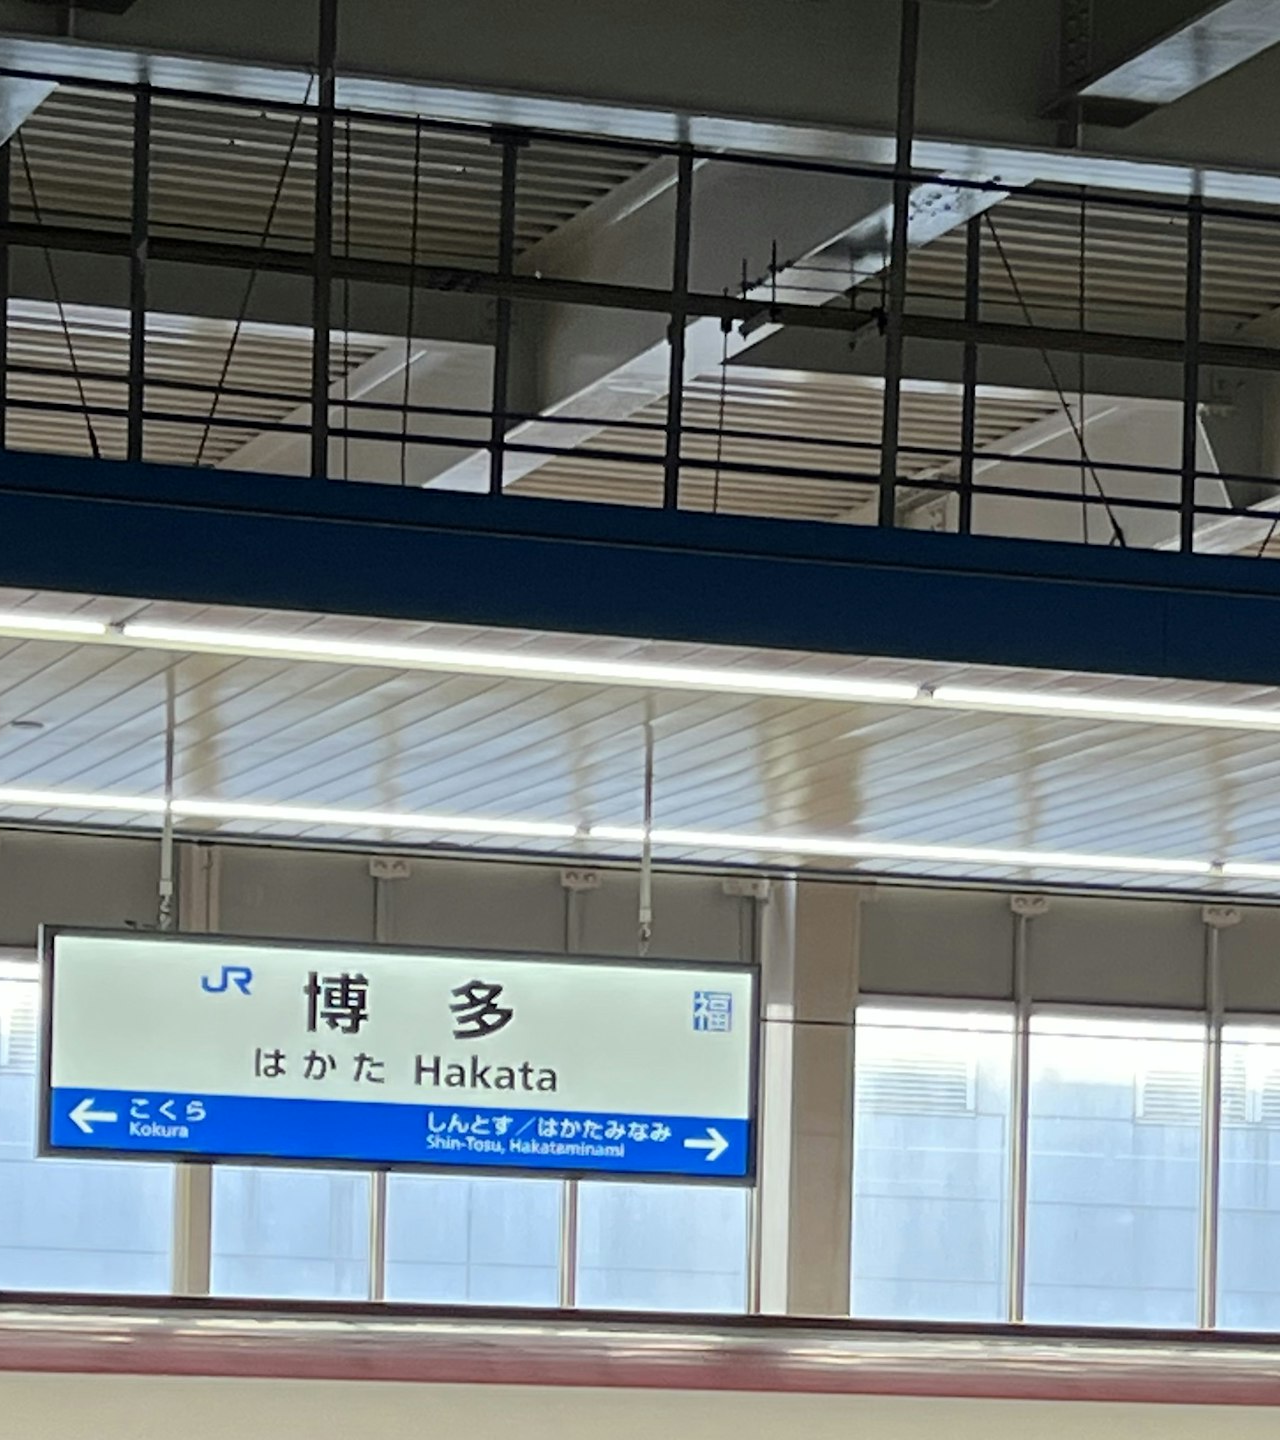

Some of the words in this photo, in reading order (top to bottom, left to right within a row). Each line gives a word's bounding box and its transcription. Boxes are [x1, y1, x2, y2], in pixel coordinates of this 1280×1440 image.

[202, 966, 253, 995] JR
[304, 971, 514, 1039] 博多
[693, 991, 732, 1032] 福
[255, 1048, 385, 1084] はかた
[414, 1054, 558, 1092] Hakata
[130, 1098, 207, 1122] こくら
[129, 1121, 190, 1138] Kokura
[426, 1133, 506, 1155] Shin-Tosu,
[509, 1138, 625, 1158] Hakataminami
